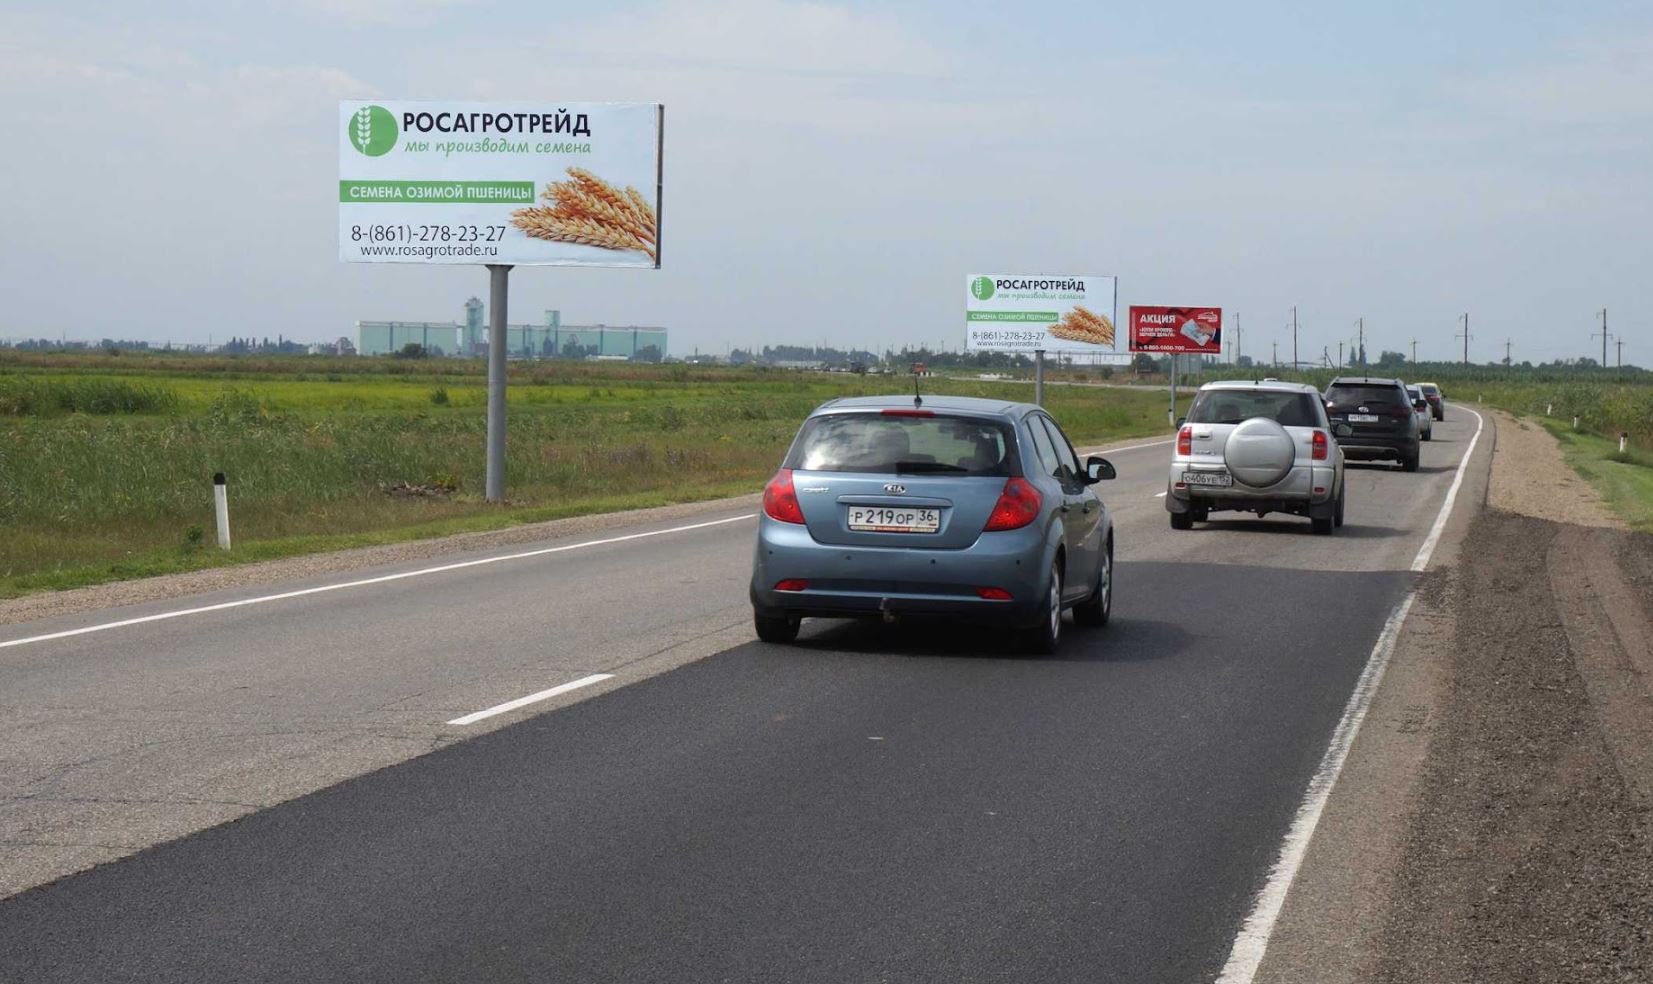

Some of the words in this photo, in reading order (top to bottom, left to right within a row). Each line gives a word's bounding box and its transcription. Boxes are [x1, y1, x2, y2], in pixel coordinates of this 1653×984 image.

[403, 108, 591, 136] РОСАГРОТРЕЙД
[405, 141, 429, 153] мы
[436, 138, 529, 157] производим
[535, 143, 591, 153] семена
[350, 186, 402, 198] СЕМЕНА
[406, 184, 463, 199] ОЗИМОЙ
[467, 187, 532, 201] ПШЕНИЦЫ
[351, 224, 506, 244] 8-(861)-278-23-27
[360, 244, 498, 259] www.rosagrotrade.ru
[996, 278, 1085, 292] РОСАГРОТРЕЙД
[1140, 314, 1176, 324] АКЦИЯ
[972, 331, 1045, 341] 8-(861)-278-23-27
[886, 485, 904, 493] KIA
[919, 510, 934, 522] 36
